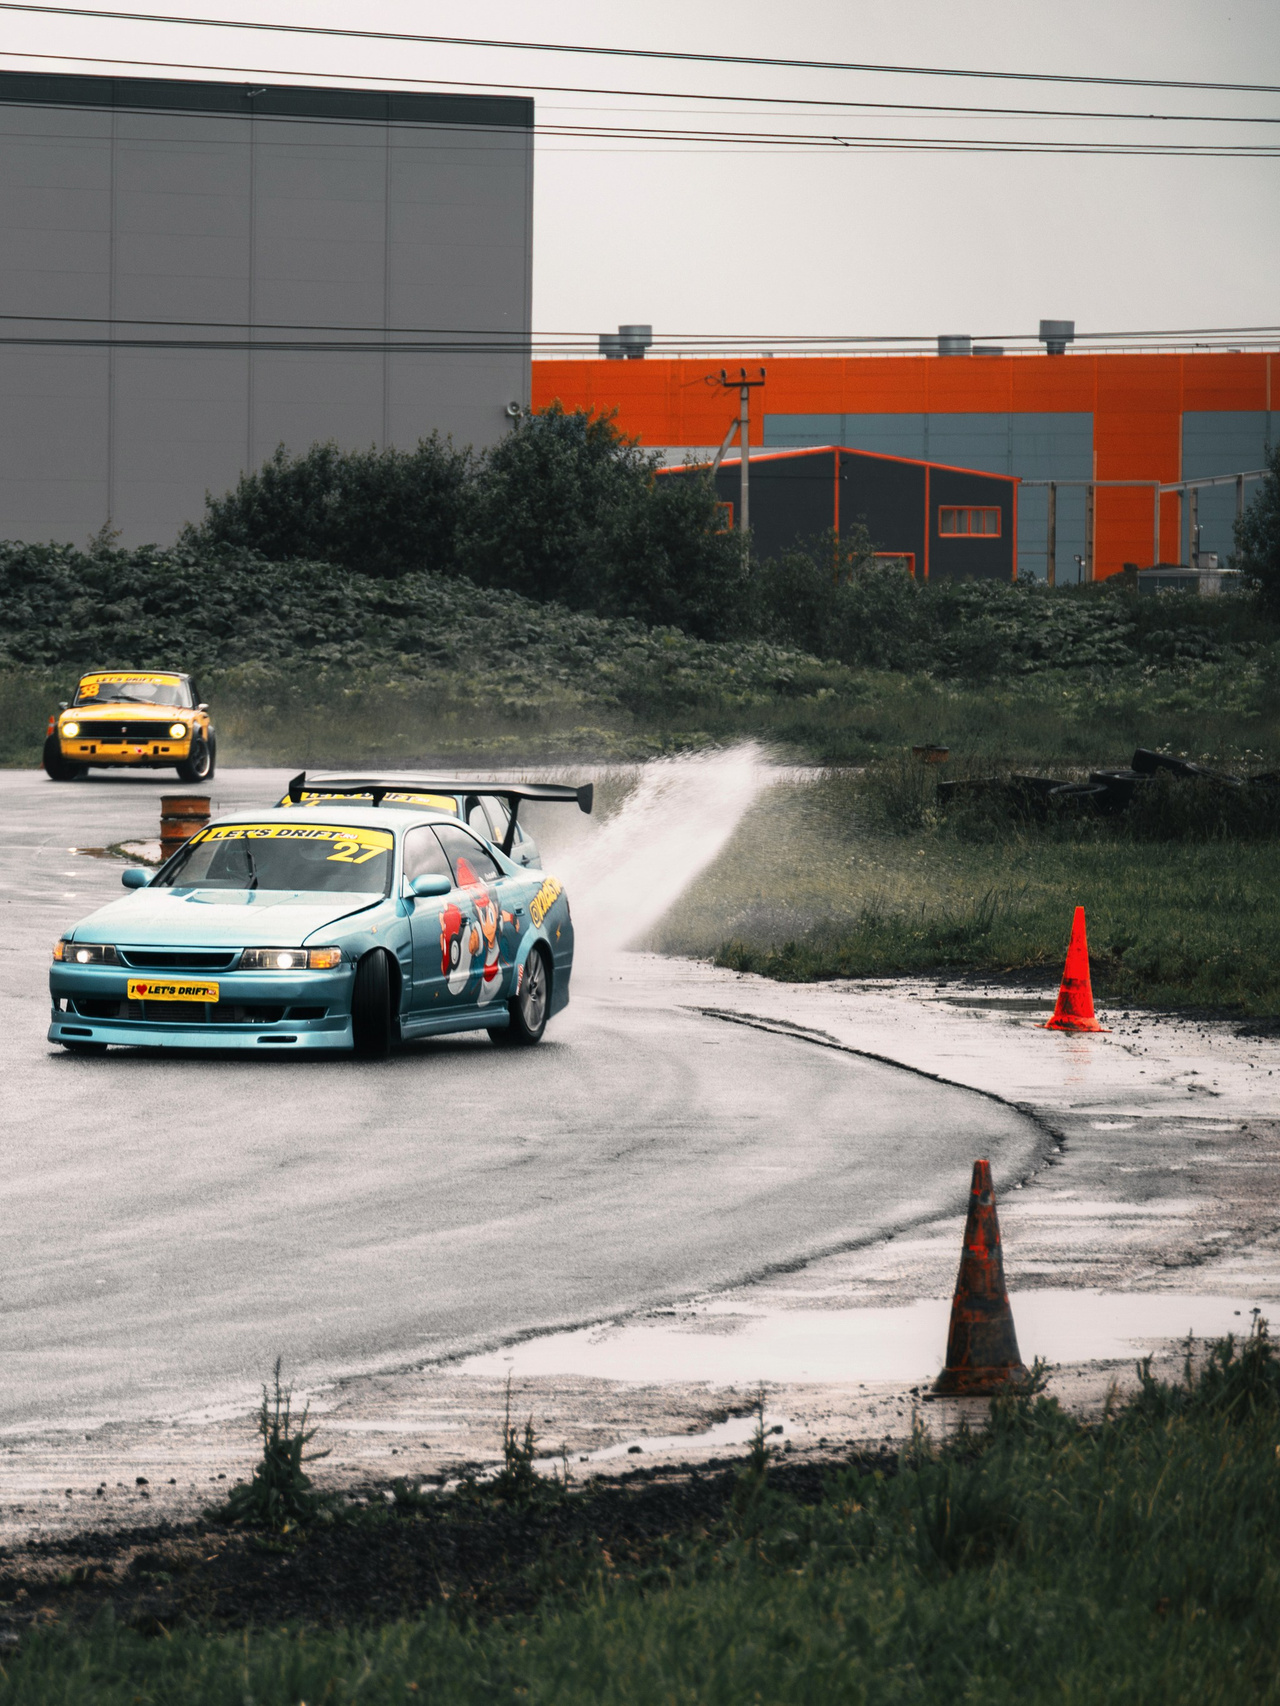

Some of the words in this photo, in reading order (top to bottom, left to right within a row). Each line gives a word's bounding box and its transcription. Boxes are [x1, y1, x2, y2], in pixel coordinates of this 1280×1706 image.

[79, 683, 100, 698] 38
[212, 828, 273, 839] LET'S
[326, 841, 387, 864] 27
[131, 985, 136, 993] I
[148, 985, 176, 994] LET'S
